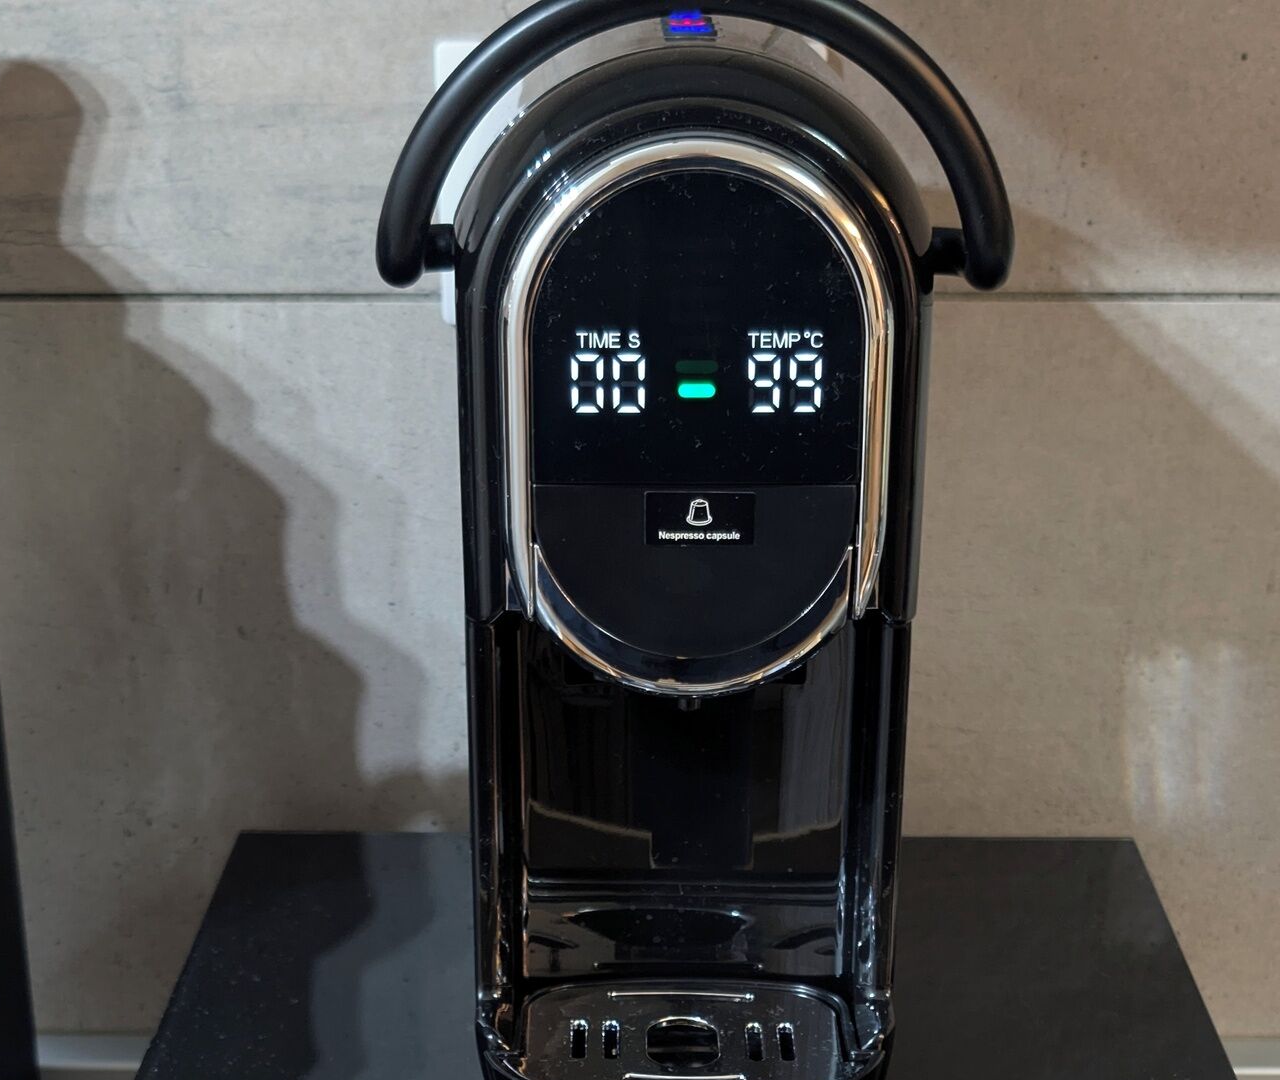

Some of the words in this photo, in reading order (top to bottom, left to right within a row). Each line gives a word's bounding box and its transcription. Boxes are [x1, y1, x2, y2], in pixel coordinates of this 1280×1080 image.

[576, 332, 621, 349] TIME
[628, 332, 641, 349] S
[748, 332, 801, 349] TEMP
[570, 353, 646, 414] 00
[747, 353, 822, 413] 99
[658, 530, 705, 541] Nespresso
[706, 530, 741, 541] capsule
